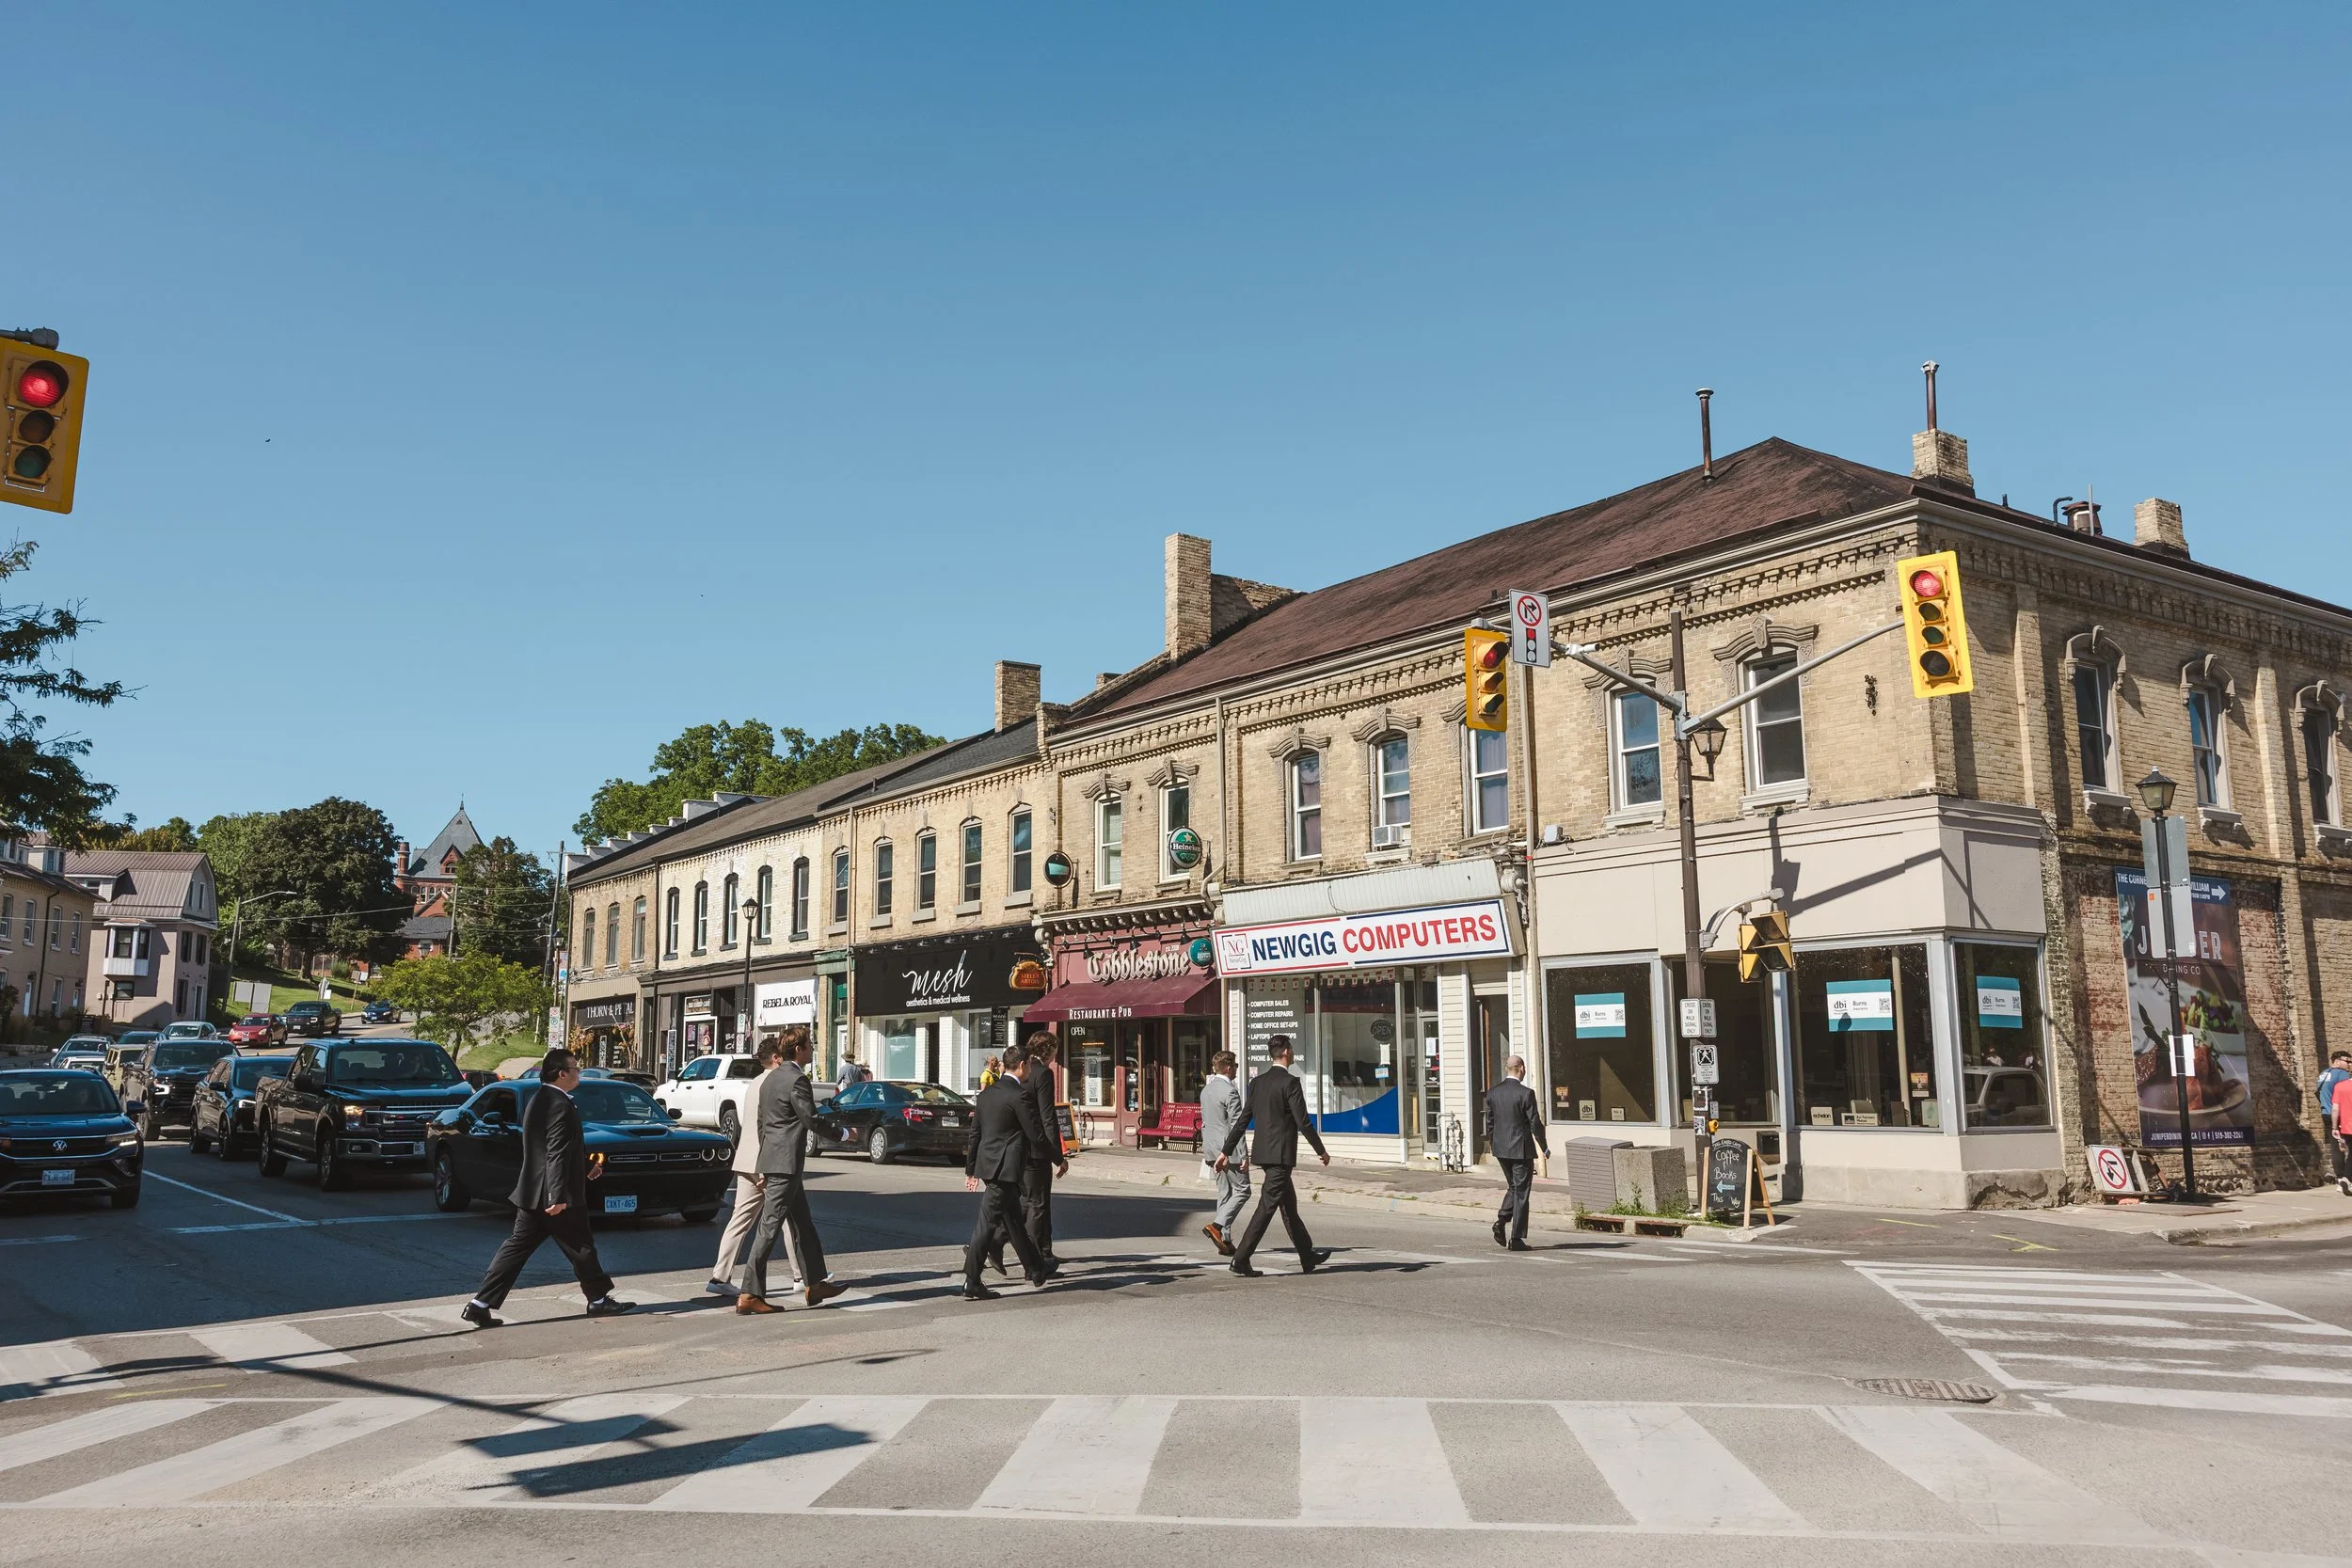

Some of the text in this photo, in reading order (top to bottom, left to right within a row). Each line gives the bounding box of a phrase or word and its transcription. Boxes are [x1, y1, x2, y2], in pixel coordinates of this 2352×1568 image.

[2117, 873, 2147, 885] THE CORNE
[1251, 914, 1496, 961] NEWGIG COMPUTERS
[1227, 940, 1244, 954] NG
[1088, 948, 1189, 982] Cobblestone
[2163, 964, 2201, 974] DING CO
[902, 950, 973, 996] mesh
[763, 998, 783, 1008] REBEL
[790, 995, 813, 1006] ROYAL
[906, 993, 970, 1007] aesthetics & medical wellness
[1834, 1000, 1847, 1009] dbi
[1982, 995, 1992, 1005] dbi
[587, 1006, 607, 1018] THORN
[1112, 1008, 1117, 1017] &
[1580, 1010, 1591, 1020] dbi
[1071, 1027, 1086, 1036] OPEN
[1372, 1024, 1391, 1035] OPEN
[1715, 1149, 1740, 1165] Coffee
[1714, 1166, 1737, 1180] Books
[1710, 1193, 1740, 1208] This Way
